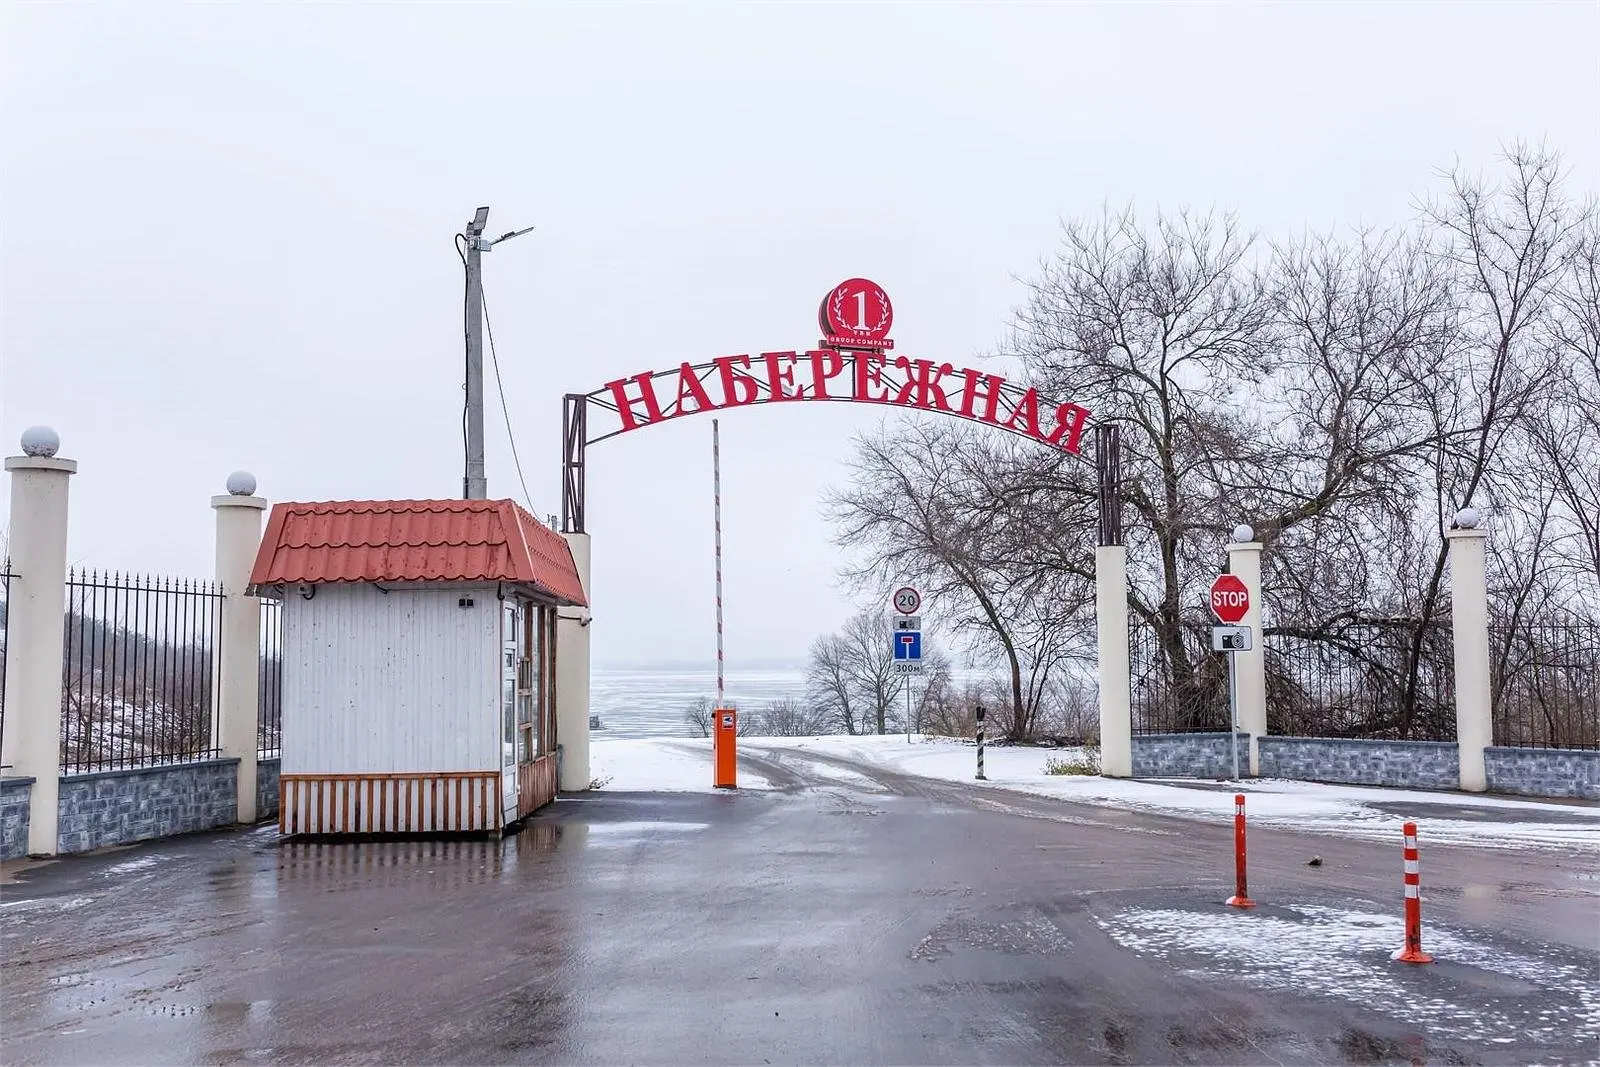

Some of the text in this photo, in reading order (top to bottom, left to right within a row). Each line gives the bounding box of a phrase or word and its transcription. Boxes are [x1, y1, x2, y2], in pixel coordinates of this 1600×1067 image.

[852, 291, 871, 330] 1
[857, 338, 892, 346] COMPANY
[606, 349, 1090, 454] НАБЕРЕЖНАЯ
[899, 596, 915, 606] 20
[1213, 592, 1247, 607] STOP
